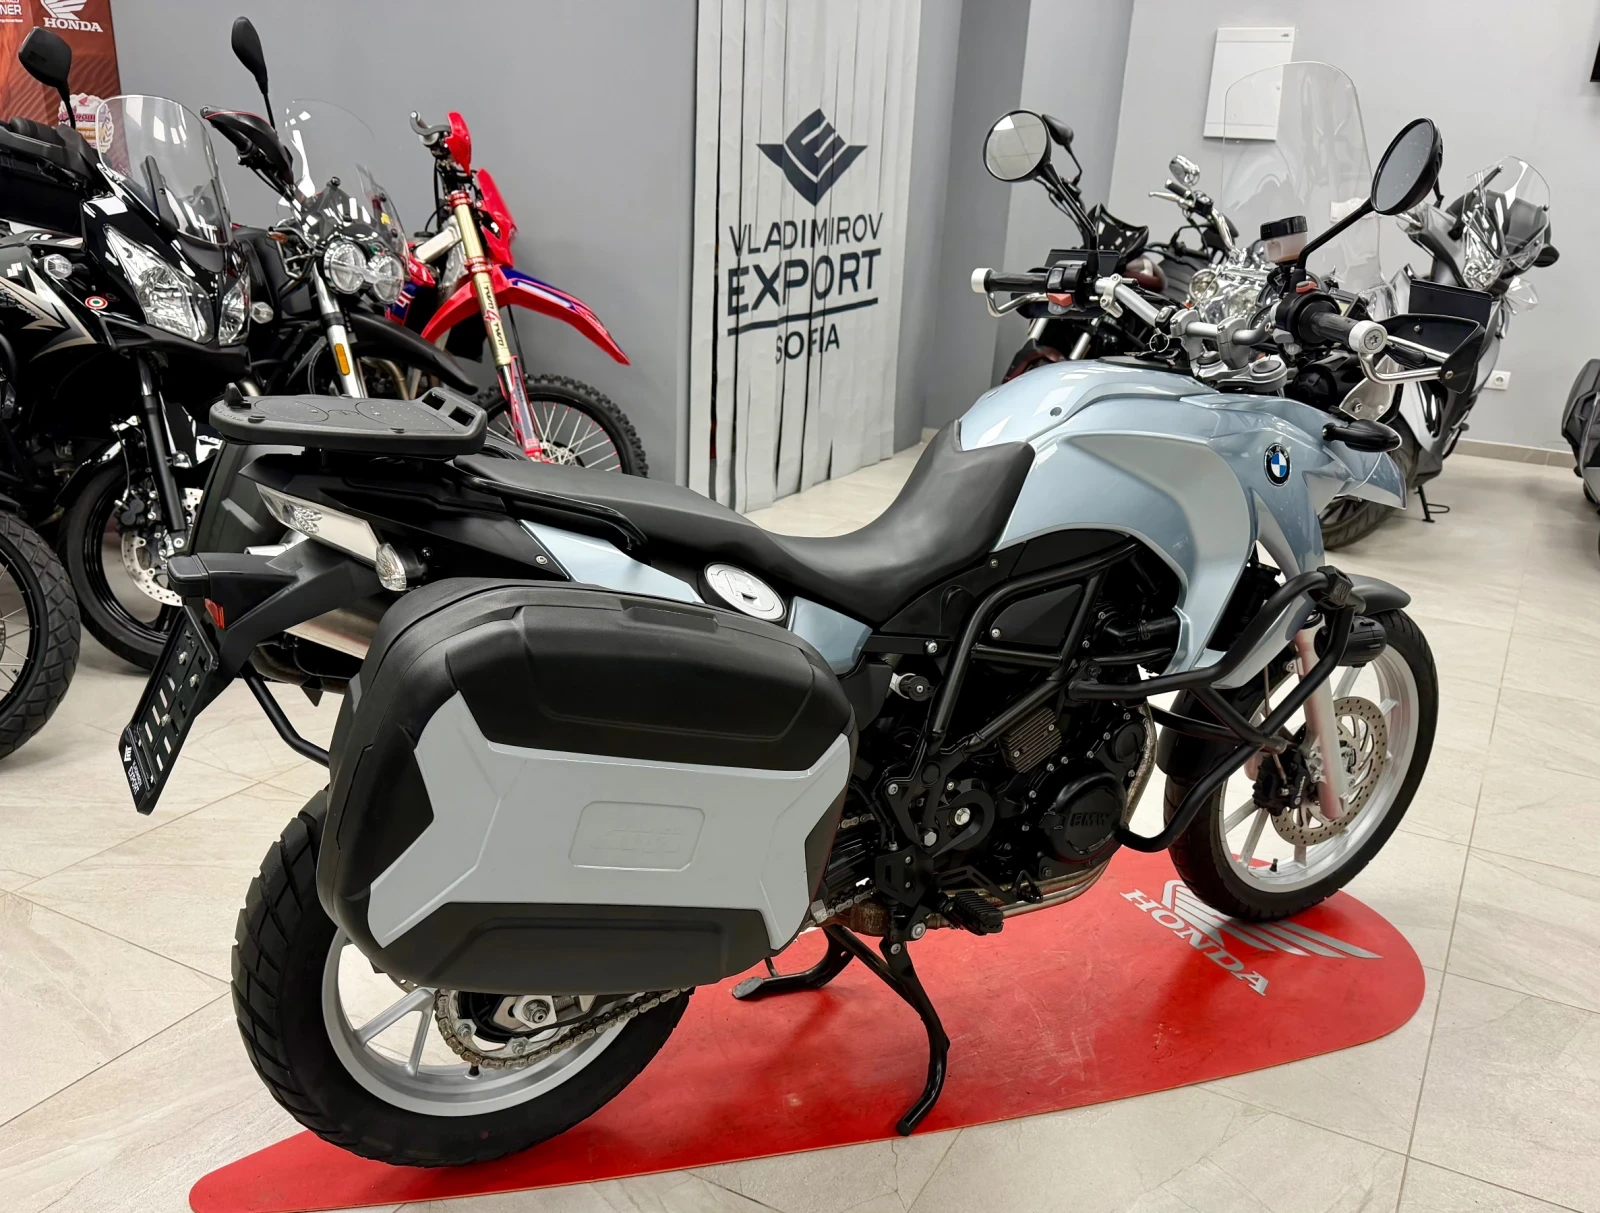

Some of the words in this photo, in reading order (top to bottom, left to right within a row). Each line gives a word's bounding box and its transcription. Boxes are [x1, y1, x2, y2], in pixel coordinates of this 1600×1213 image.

[43, 17, 103, 32] HONDA
[729, 212, 883, 257] VLADIMIROV
[727, 248, 881, 316] EXPORT
[775, 323, 840, 364] SOFIA
[1119, 888, 1269, 997] HONDA
